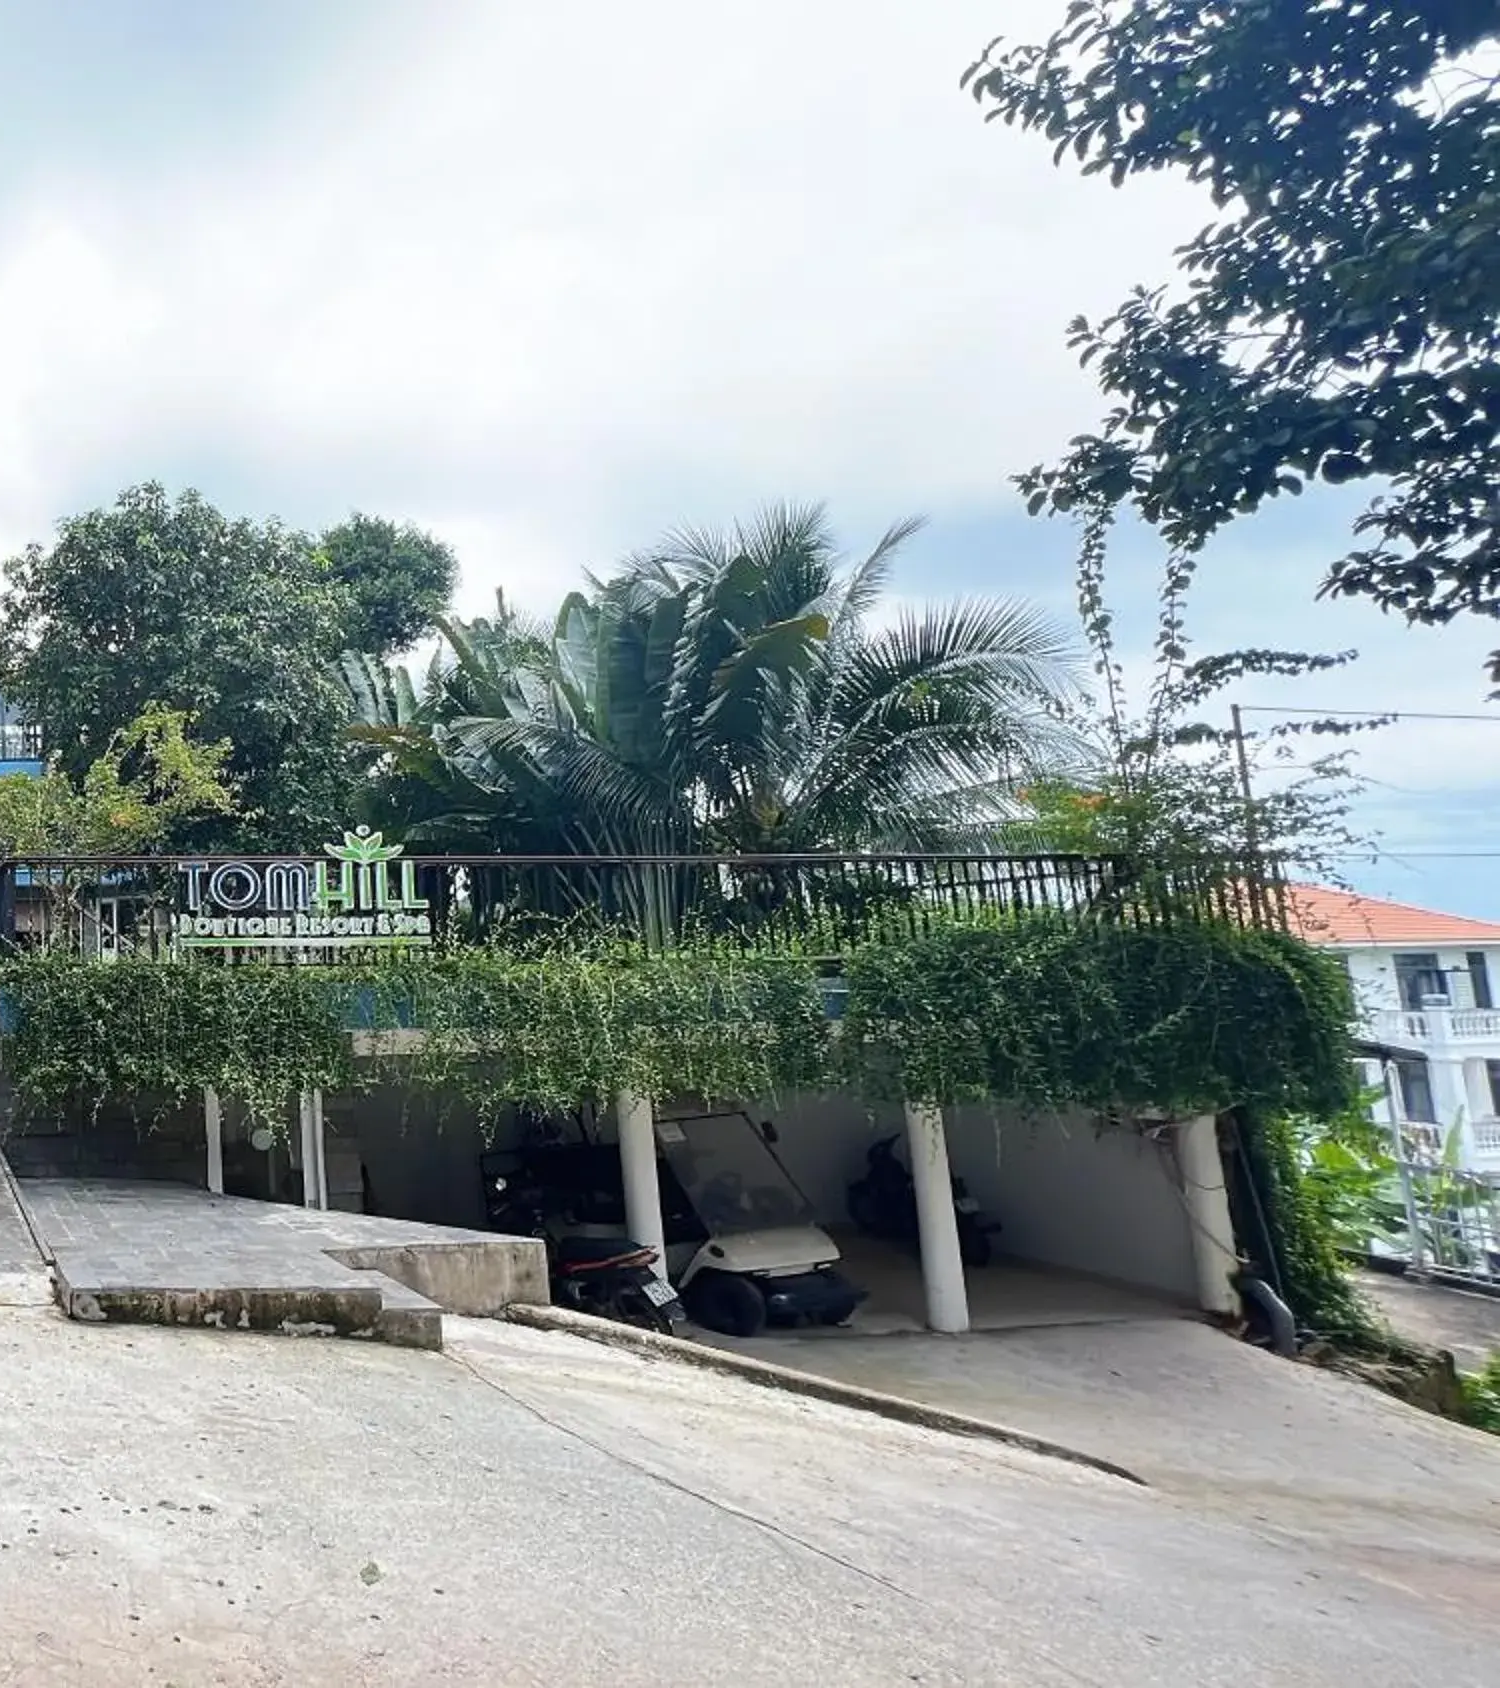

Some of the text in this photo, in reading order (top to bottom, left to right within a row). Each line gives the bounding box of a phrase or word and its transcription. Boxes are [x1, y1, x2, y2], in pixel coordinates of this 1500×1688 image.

[178, 860, 429, 911] TOMHILL
[296, 913, 374, 935] RESORT
[377, 913, 391, 935] &
